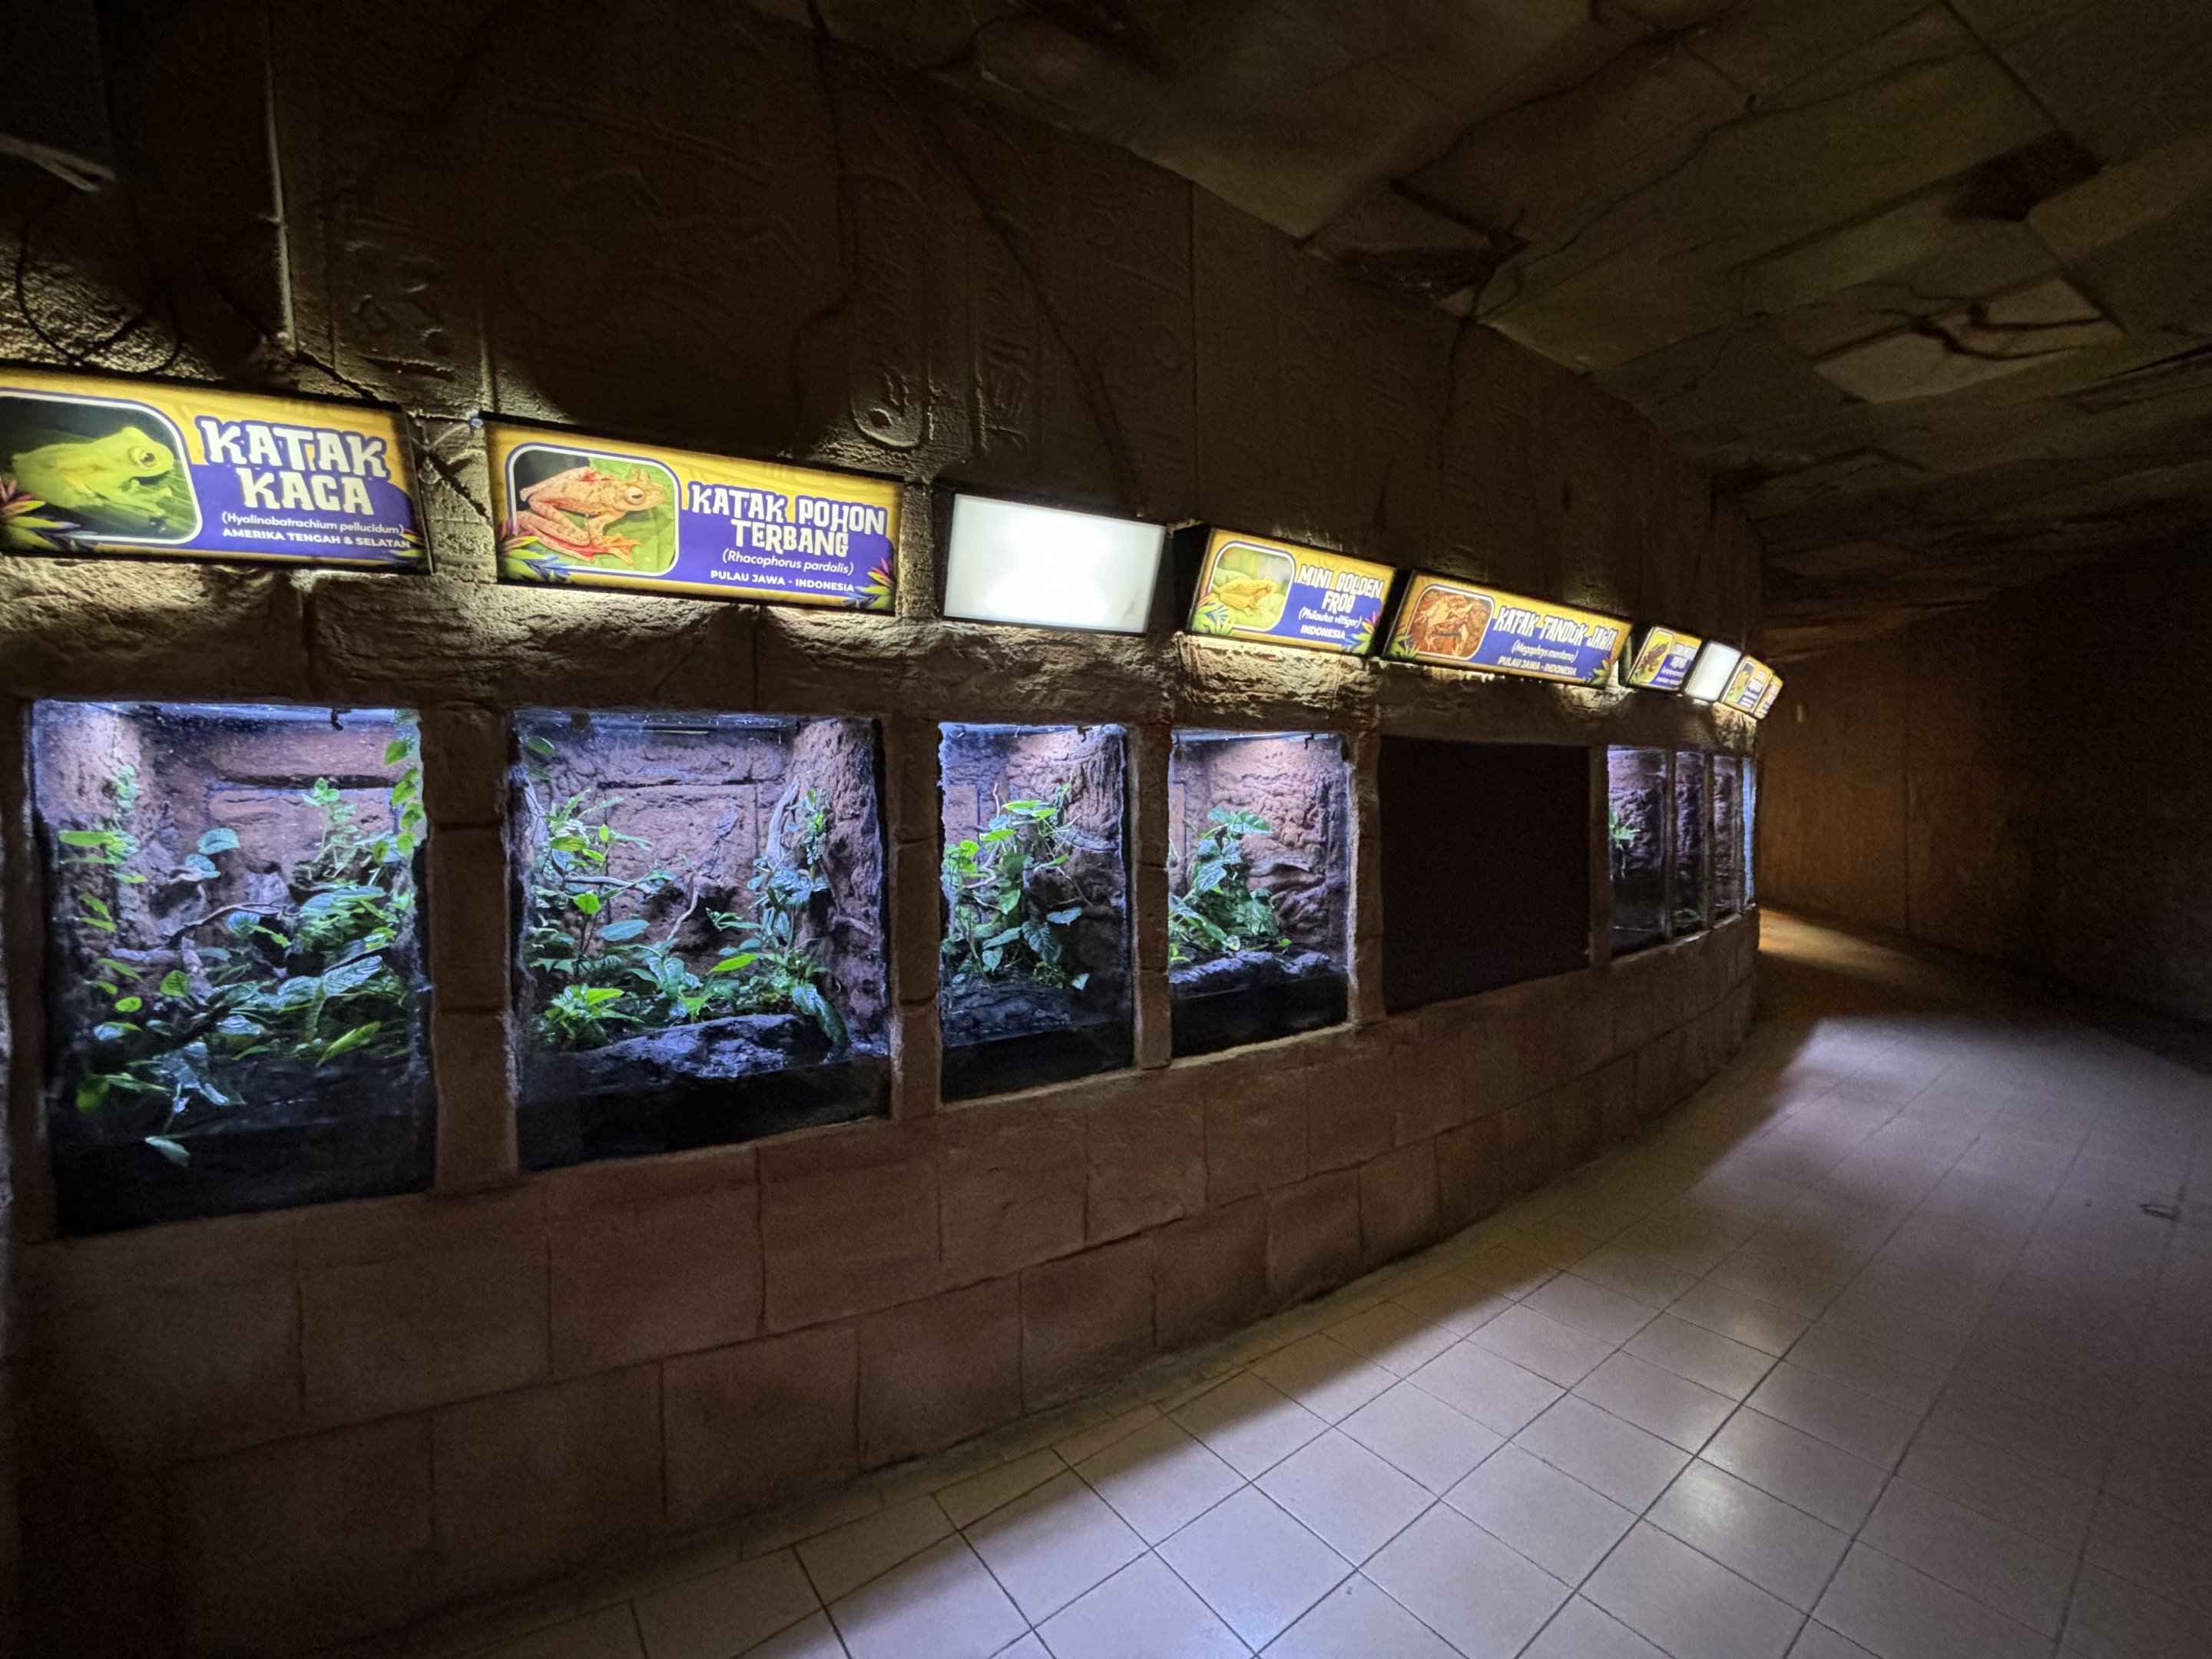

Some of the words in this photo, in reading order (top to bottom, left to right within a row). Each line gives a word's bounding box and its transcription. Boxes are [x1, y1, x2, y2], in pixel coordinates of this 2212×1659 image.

[201, 420, 386, 477] KATAK
[237, 467, 375, 515] KACA
[222, 512, 337, 530] (Hyalinobatrachium
[340, 522, 405, 535] pellucidum)
[691, 485, 785, 522] KATAK
[799, 498, 885, 535] POHON
[223, 528, 286, 541] AMERIKA
[287, 532, 340, 544] TENGAH
[344, 535, 353, 545] &
[355, 537, 411, 548] SELATAN
[731, 519, 848, 558] TERBANG
[722, 548, 802, 569] (Rhacophorus
[803, 561, 854, 576] pardalis)
[710, 570, 750, 582] PULAU
[752, 575, 785, 585] JAWA
[796, 579, 854, 592] INDONESIA
[1297, 565, 1333, 589] MINI
[1336, 572, 1384, 598] GOLDEN
[1322, 591, 1356, 614] FROG
[1300, 624, 1345, 639] INDONESIA
[1493, 607, 1539, 637] KATAK
[1539, 615, 1588, 646] TANDUK
[1587, 626, 1618, 651] JAWA
[1543, 664, 1577, 675] INDONESIA
